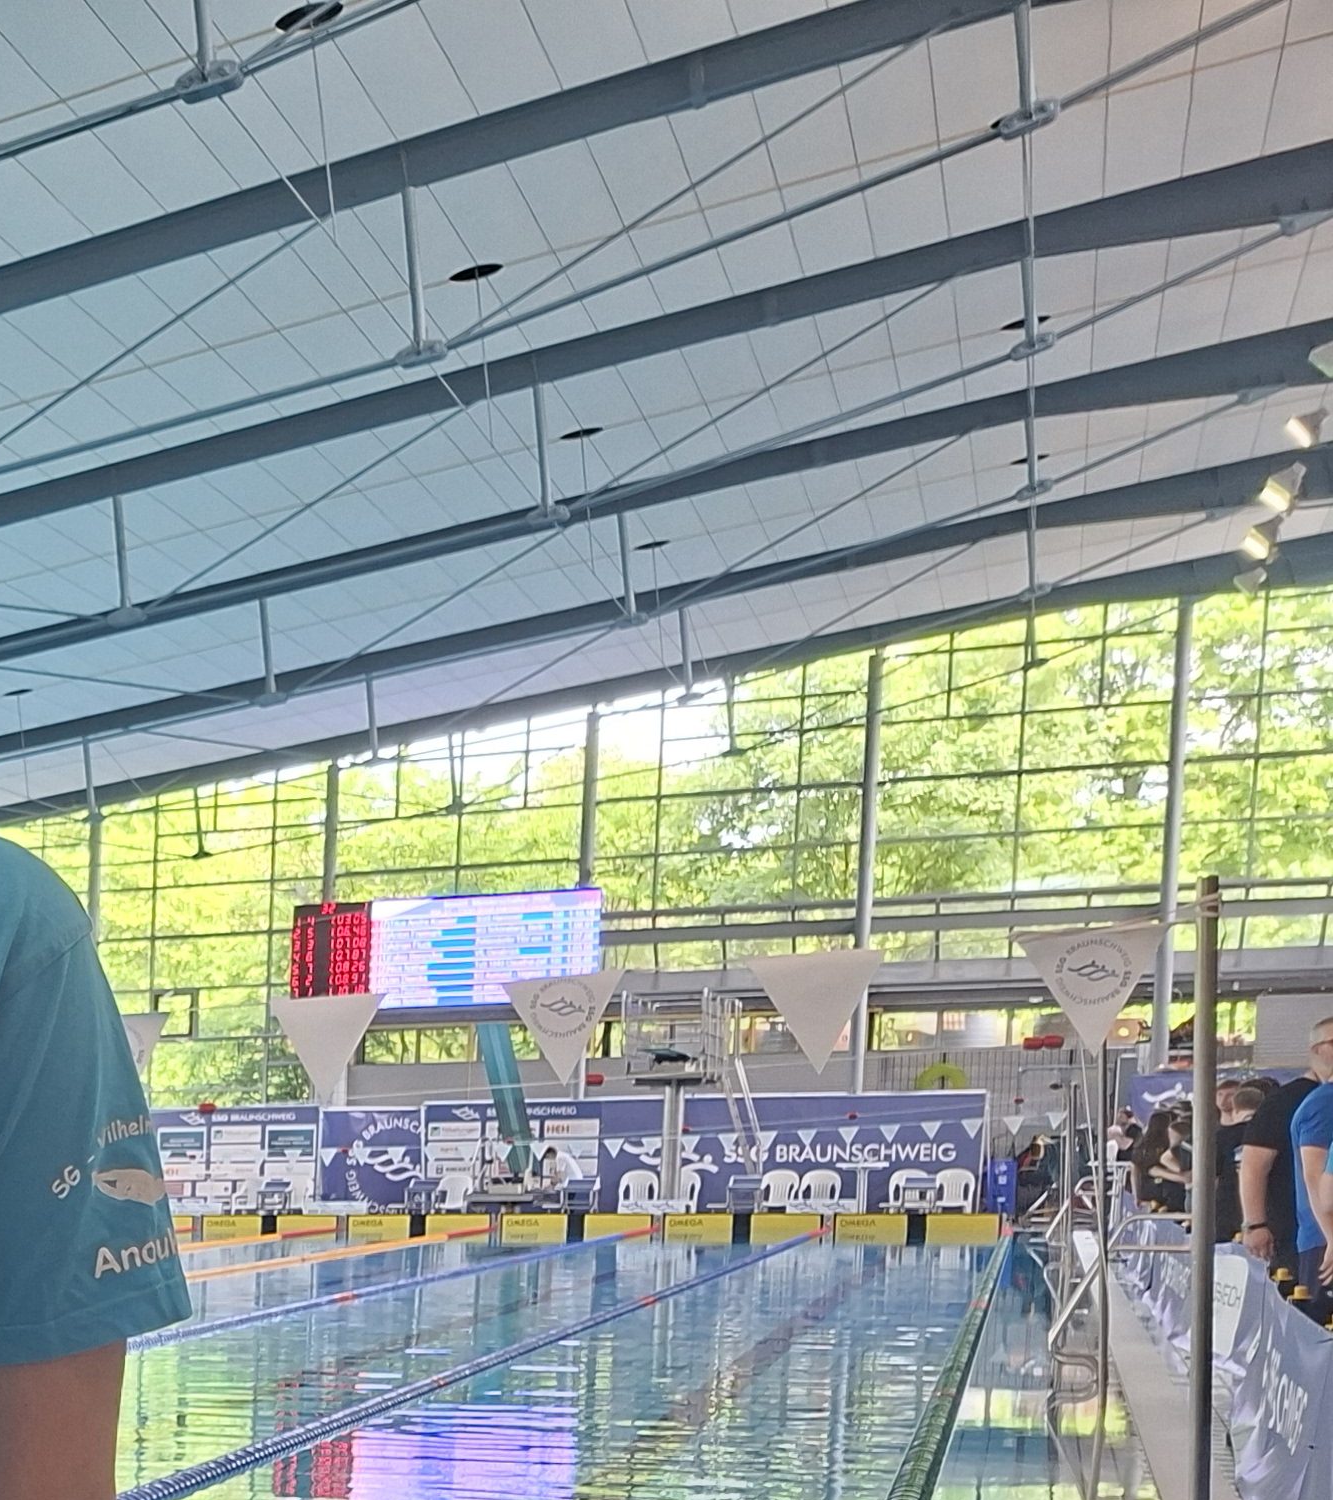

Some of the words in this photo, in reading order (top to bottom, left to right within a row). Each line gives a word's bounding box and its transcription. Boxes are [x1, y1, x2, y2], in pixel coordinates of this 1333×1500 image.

[723, 1144, 769, 1163] SSG
[775, 1142, 958, 1163] BRAUNSCHWEIG
[51, 1165, 81, 1199] SG
